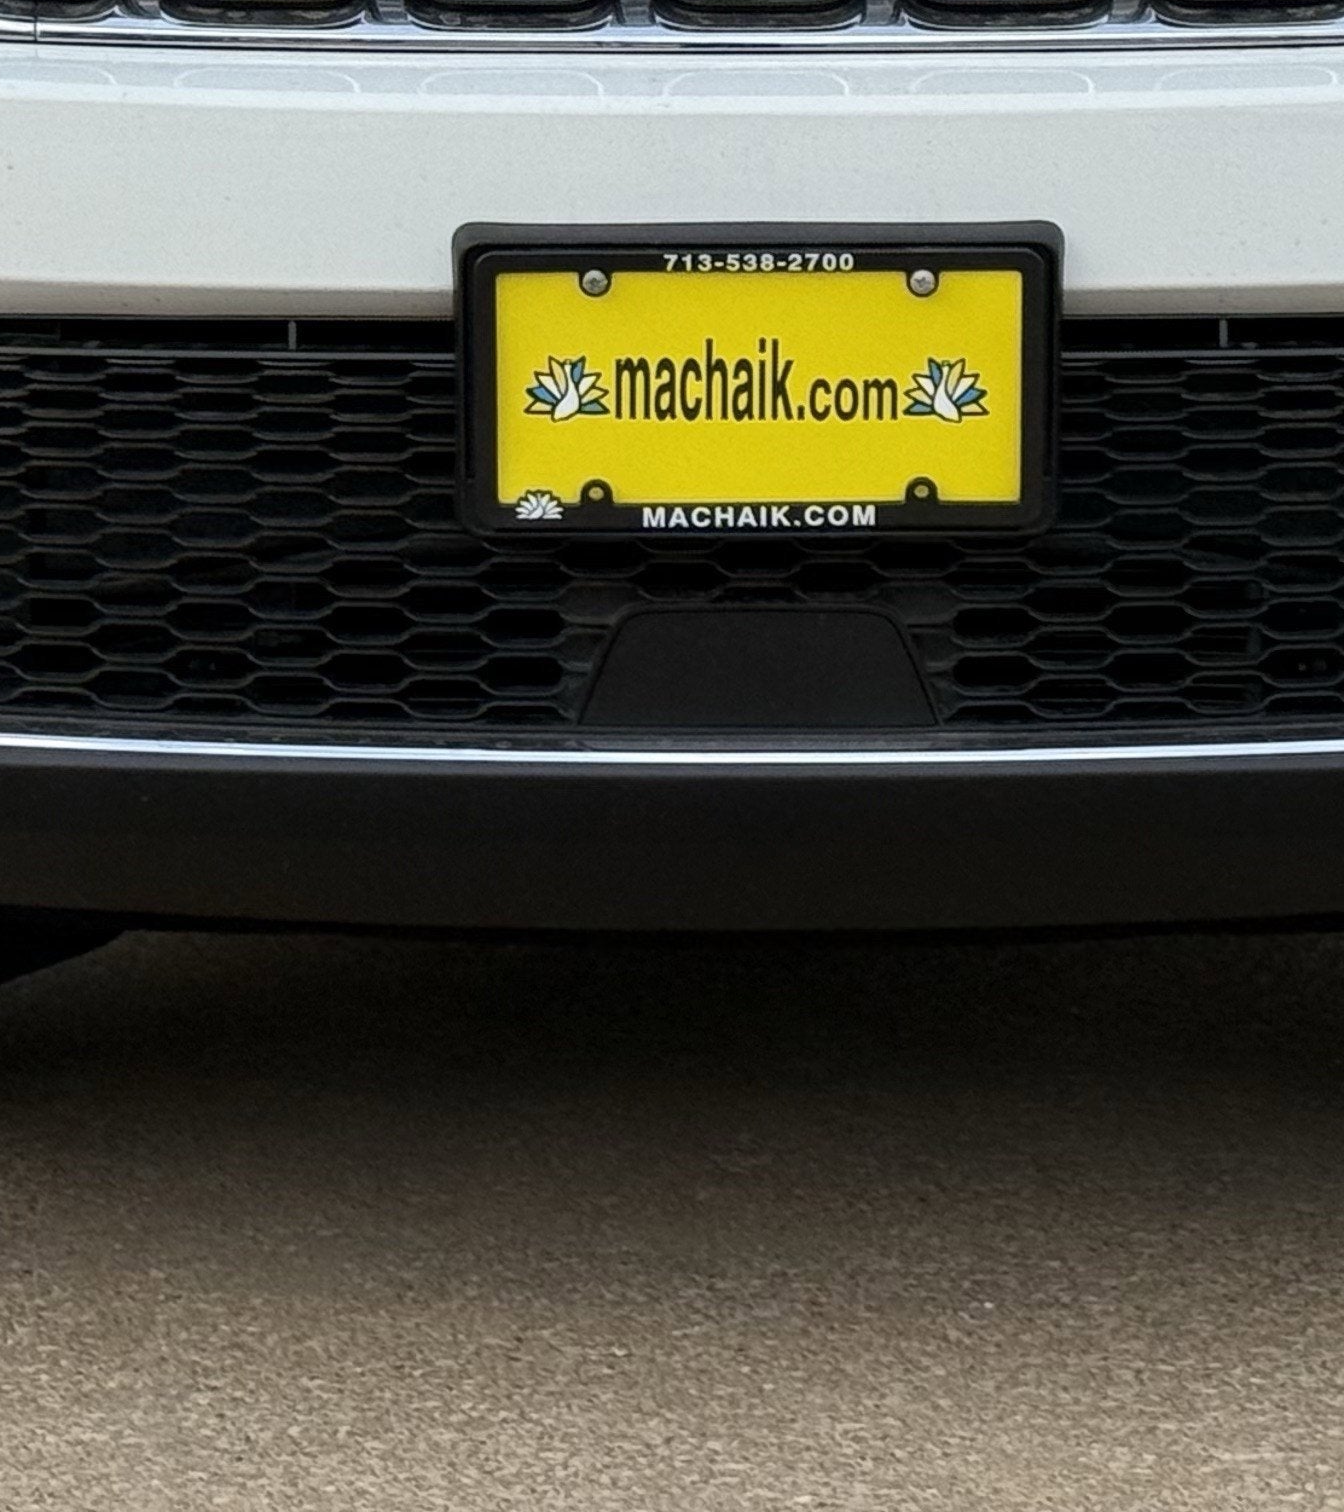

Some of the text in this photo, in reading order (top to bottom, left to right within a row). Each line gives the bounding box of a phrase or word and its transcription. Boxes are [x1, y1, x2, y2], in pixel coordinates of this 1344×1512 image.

[662, 252, 856, 273] 713-538-2700
[614, 337, 899, 422] machaik.com
[641, 504, 877, 529] MACHAIK.COM
